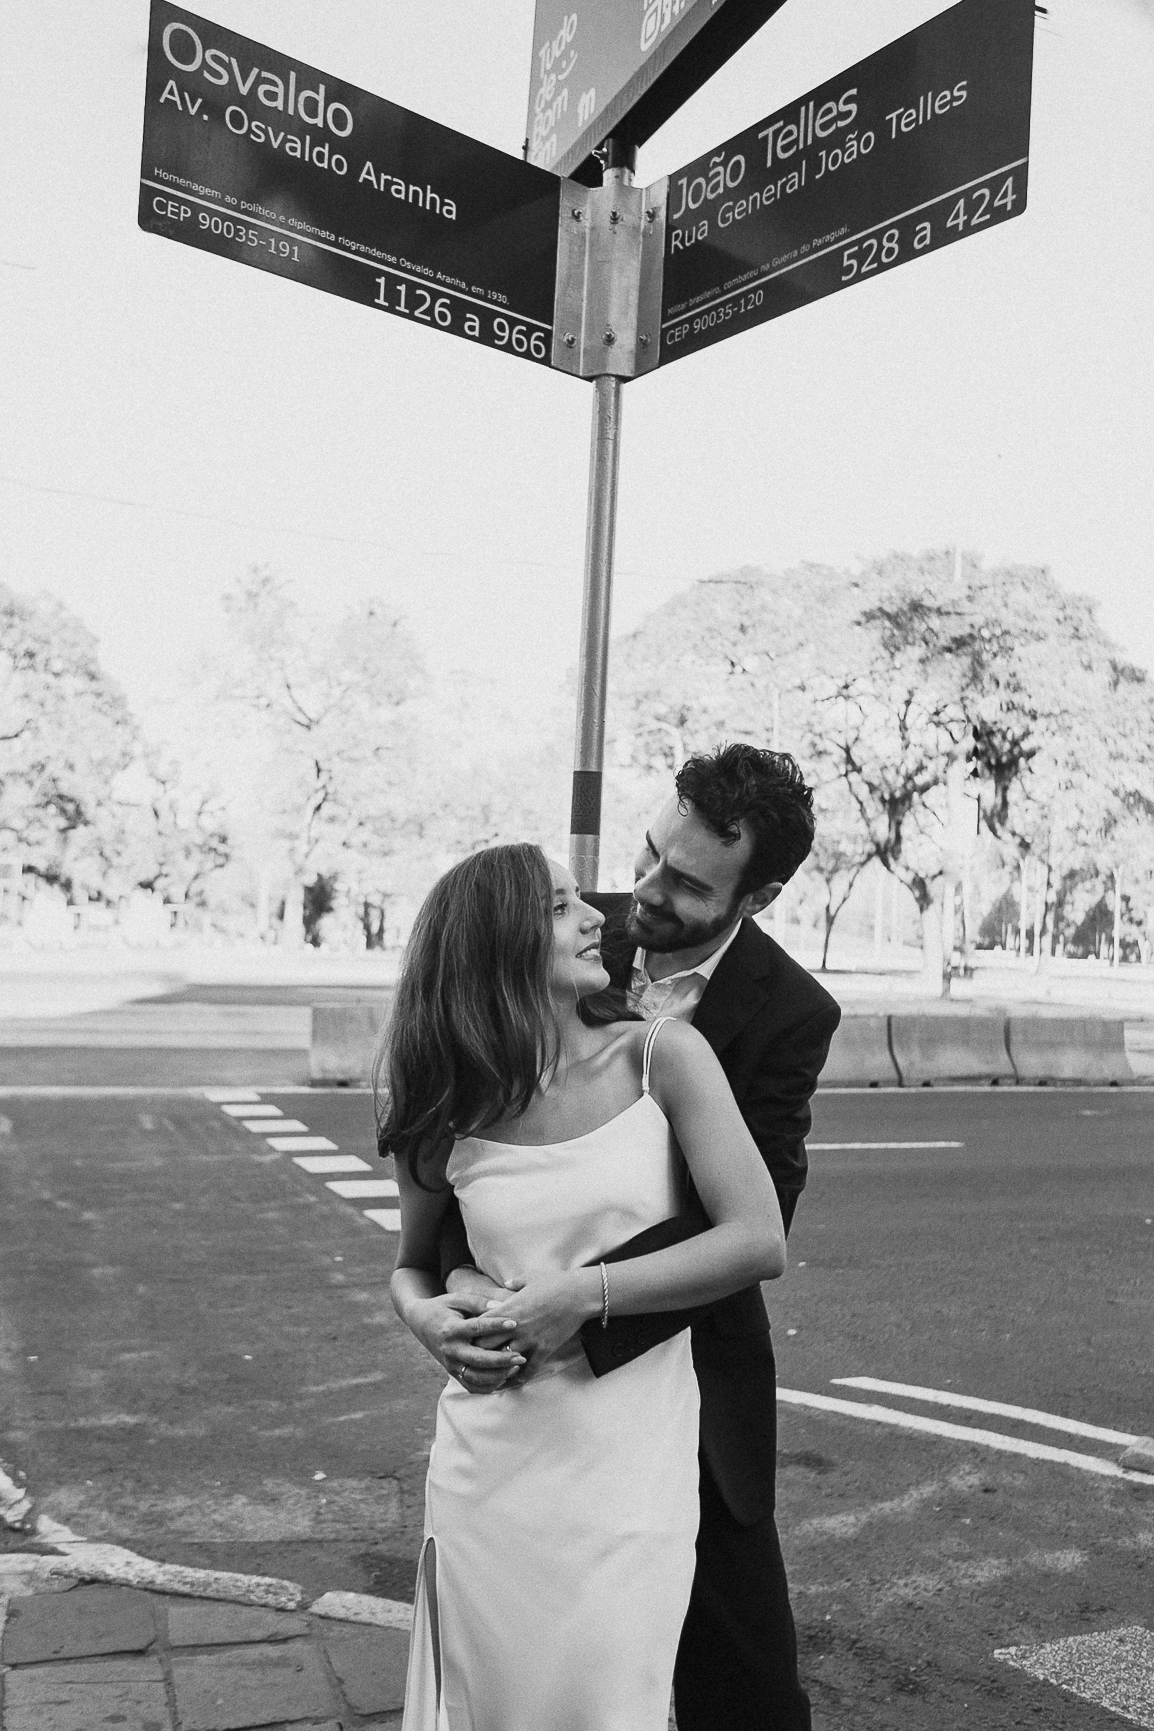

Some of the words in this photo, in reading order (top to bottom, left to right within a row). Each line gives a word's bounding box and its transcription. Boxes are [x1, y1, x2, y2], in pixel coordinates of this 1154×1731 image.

[162, 22, 354, 137] Osvaldo
[539, 13, 577, 78] Tudo
[535, 73, 556, 114] de
[159, 80, 208, 121] Av.
[225, 106, 348, 175] Osvaldo
[359, 162, 457, 220] Aranha
[671, 217, 709, 254] Rua
[718, 160, 806, 228] General
[815, 130, 875, 179] João
[885, 80, 967, 139] Telles
[673, 151, 746, 219] João
[758, 87, 858, 167] Telles
[152, 197, 192, 221] CEP
[198, 213, 300, 262] 90035-191
[154, 167, 221, 199] Homenagem
[225, 195, 237, 205] ao
[288, 218, 336, 241] diplomata
[339, 236, 397, 263] riograndense
[400, 258, 434, 277] Osvaldo
[436, 272, 468, 292] Aranha,
[472, 285, 484, 295] em
[487, 290, 510, 304] 1930.
[724, 268, 758, 289] combateu
[760, 263, 769, 272] na
[772, 250, 798, 266] Guerra
[800, 244, 810, 254] do
[813, 224, 849, 248] Paraguai.
[841, 228, 899, 282] 528
[913, 222, 931, 249] a
[946, 177, 1016, 232] 424
[374, 276, 451, 327] 1126
[464, 313, 480, 337] a
[493, 318, 546, 358] 966
[666, 324, 689, 345] CEP
[693, 290, 763, 333] 90035-120
